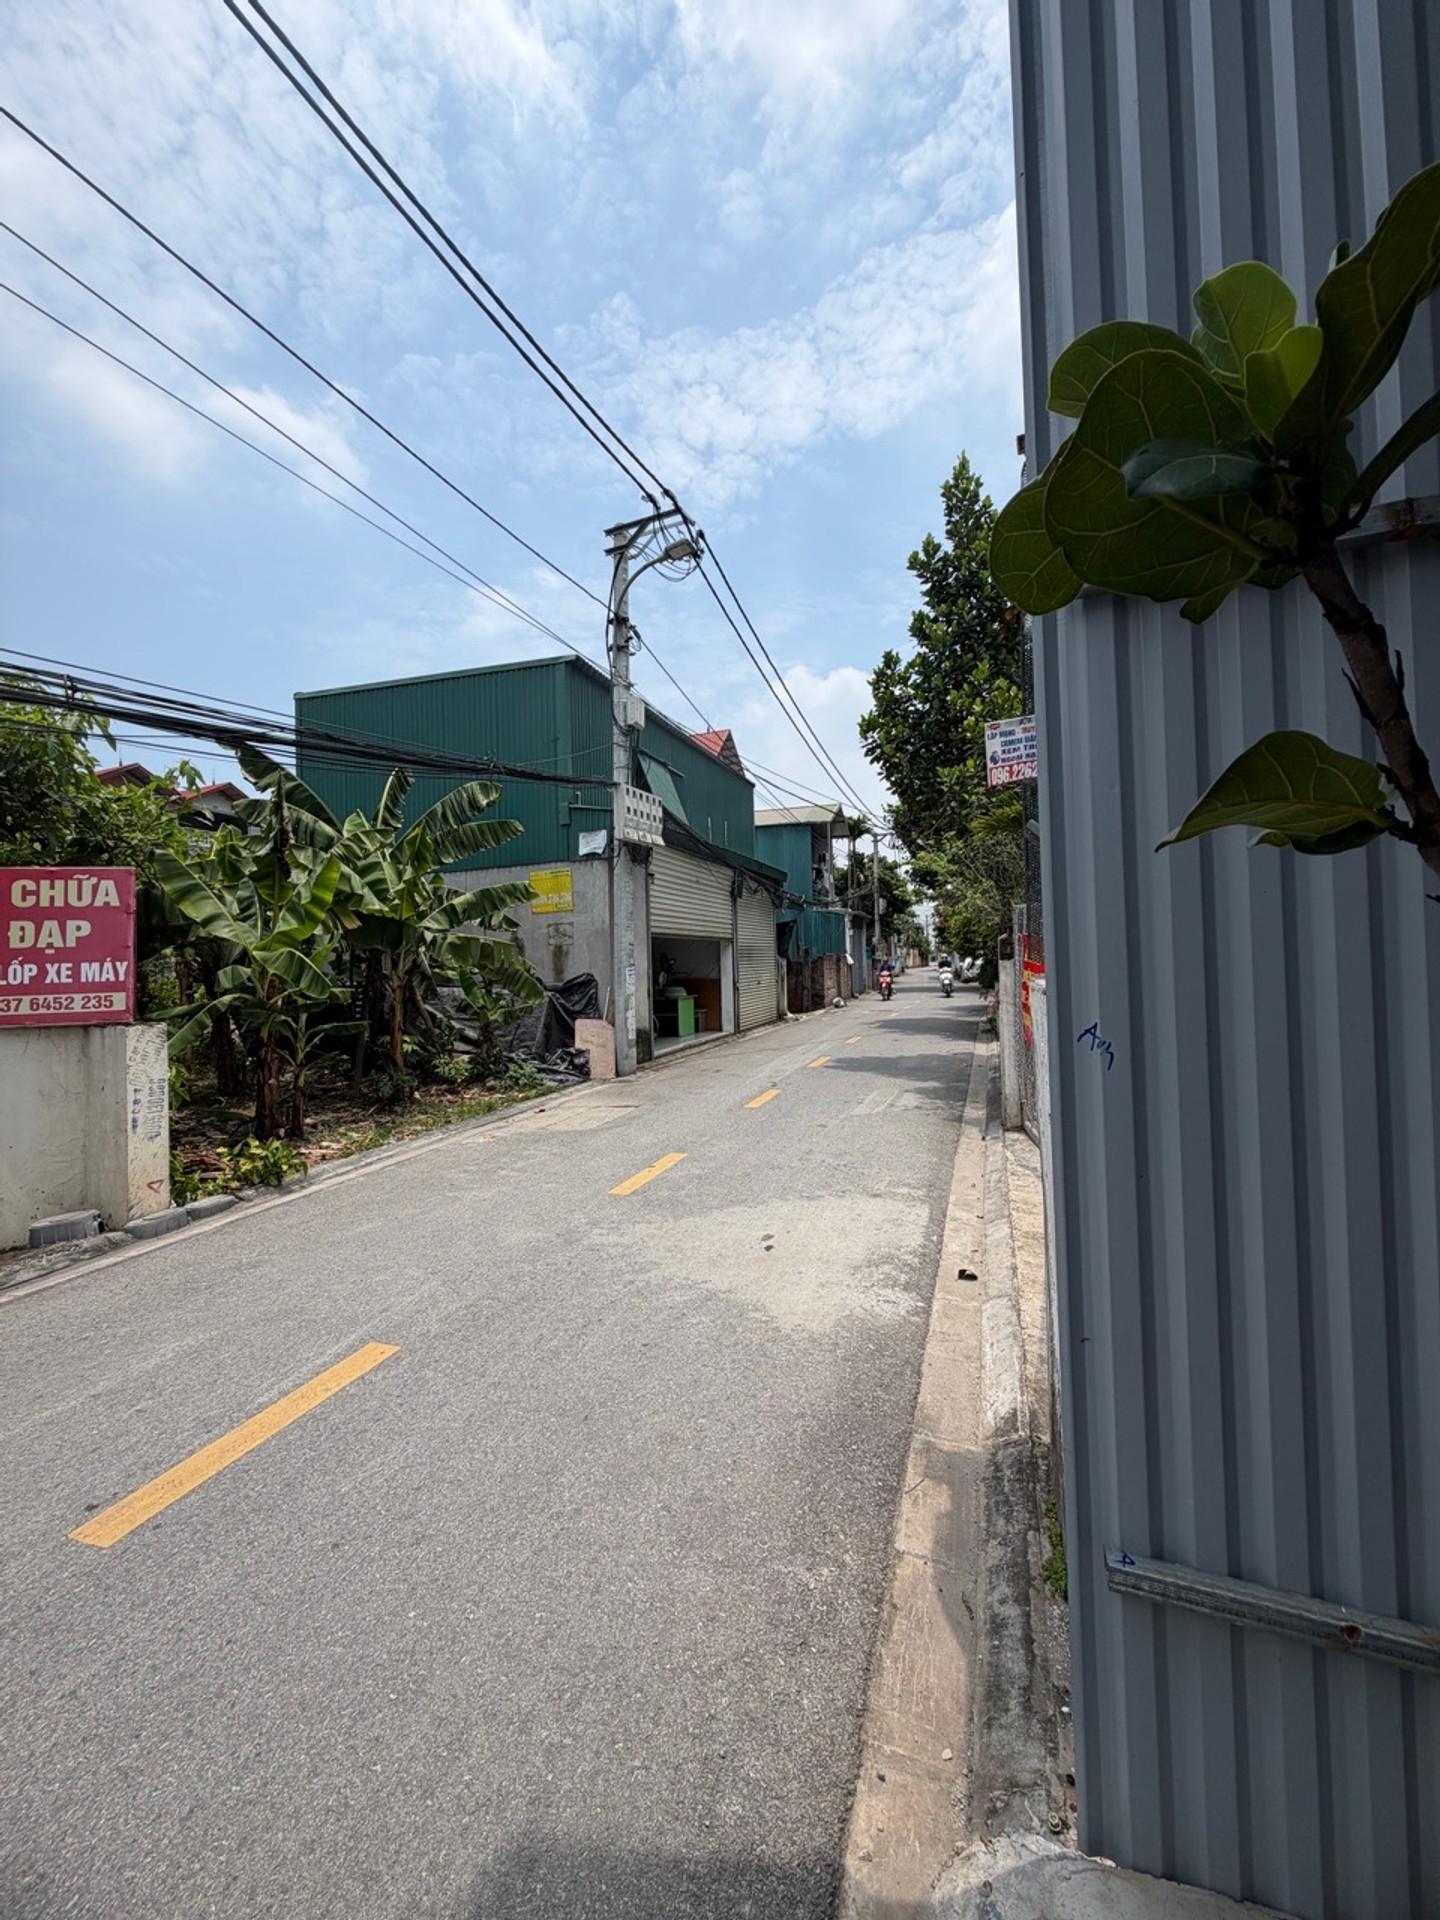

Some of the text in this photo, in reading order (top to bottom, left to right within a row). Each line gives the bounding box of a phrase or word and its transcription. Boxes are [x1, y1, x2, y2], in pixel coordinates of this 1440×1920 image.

[10, 874, 121, 908] CHỮA
[7, 919, 92, 955] ĐẠP
[44, 962, 73, 984] XE
[80, 957, 129, 983] MÁY
[29, 996, 75, 1012] 6452
[80, 994, 114, 1010] 235
